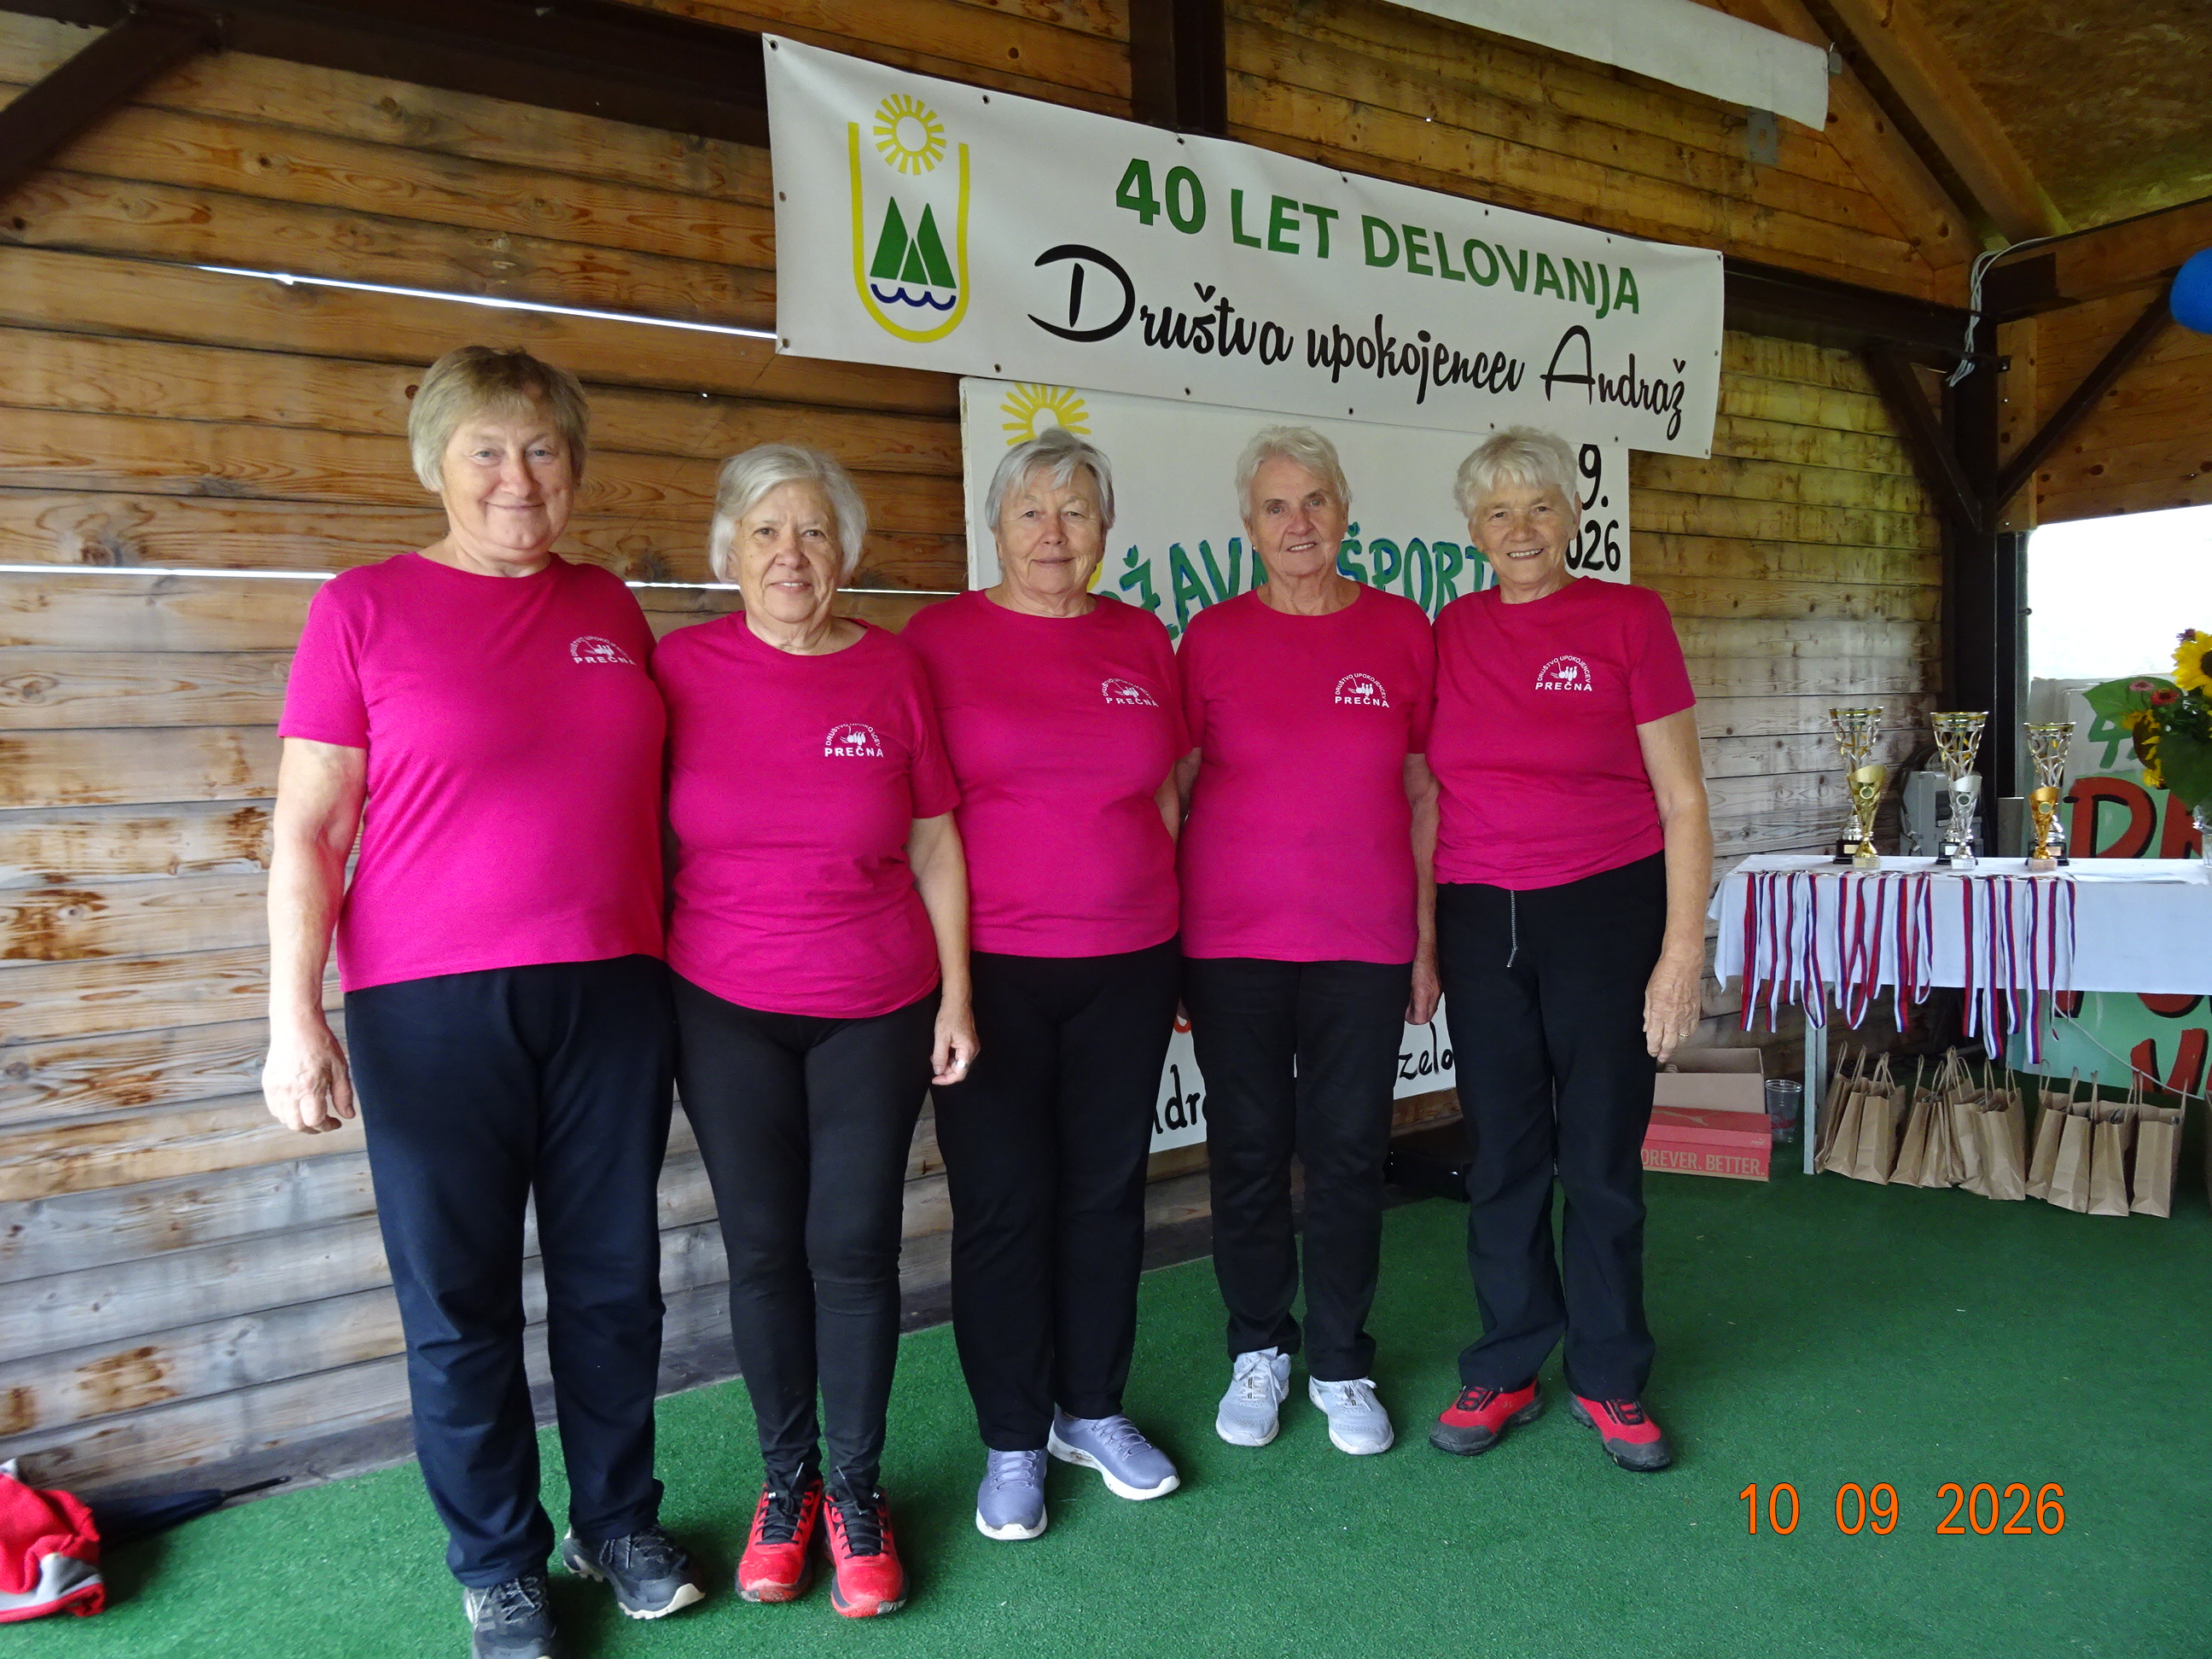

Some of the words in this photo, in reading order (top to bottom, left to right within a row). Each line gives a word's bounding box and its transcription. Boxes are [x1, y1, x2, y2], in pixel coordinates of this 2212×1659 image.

[1115, 157, 1207, 236] 40
[1230, 188, 1340, 259] LET
[1360, 213, 1640, 320] DELOVANJA
[1027, 243, 1295, 366] Društva
[1306, 313, 1526, 405] upokojencev
[1540, 324, 1686, 442] Andraž
[1565, 519, 1621, 573] 026
[1336, 521, 1499, 620] ŠPORT
[1559, 655, 1592, 684] UPOKOJENCEV
[1534, 681, 1593, 692] PREČNA
[1334, 695, 1391, 708] PREČNA
[824, 745, 885, 758] PREČNA
[1640, 1148, 1703, 1171] OREVER.
[1706, 1154, 1766, 1176] BETTER.
